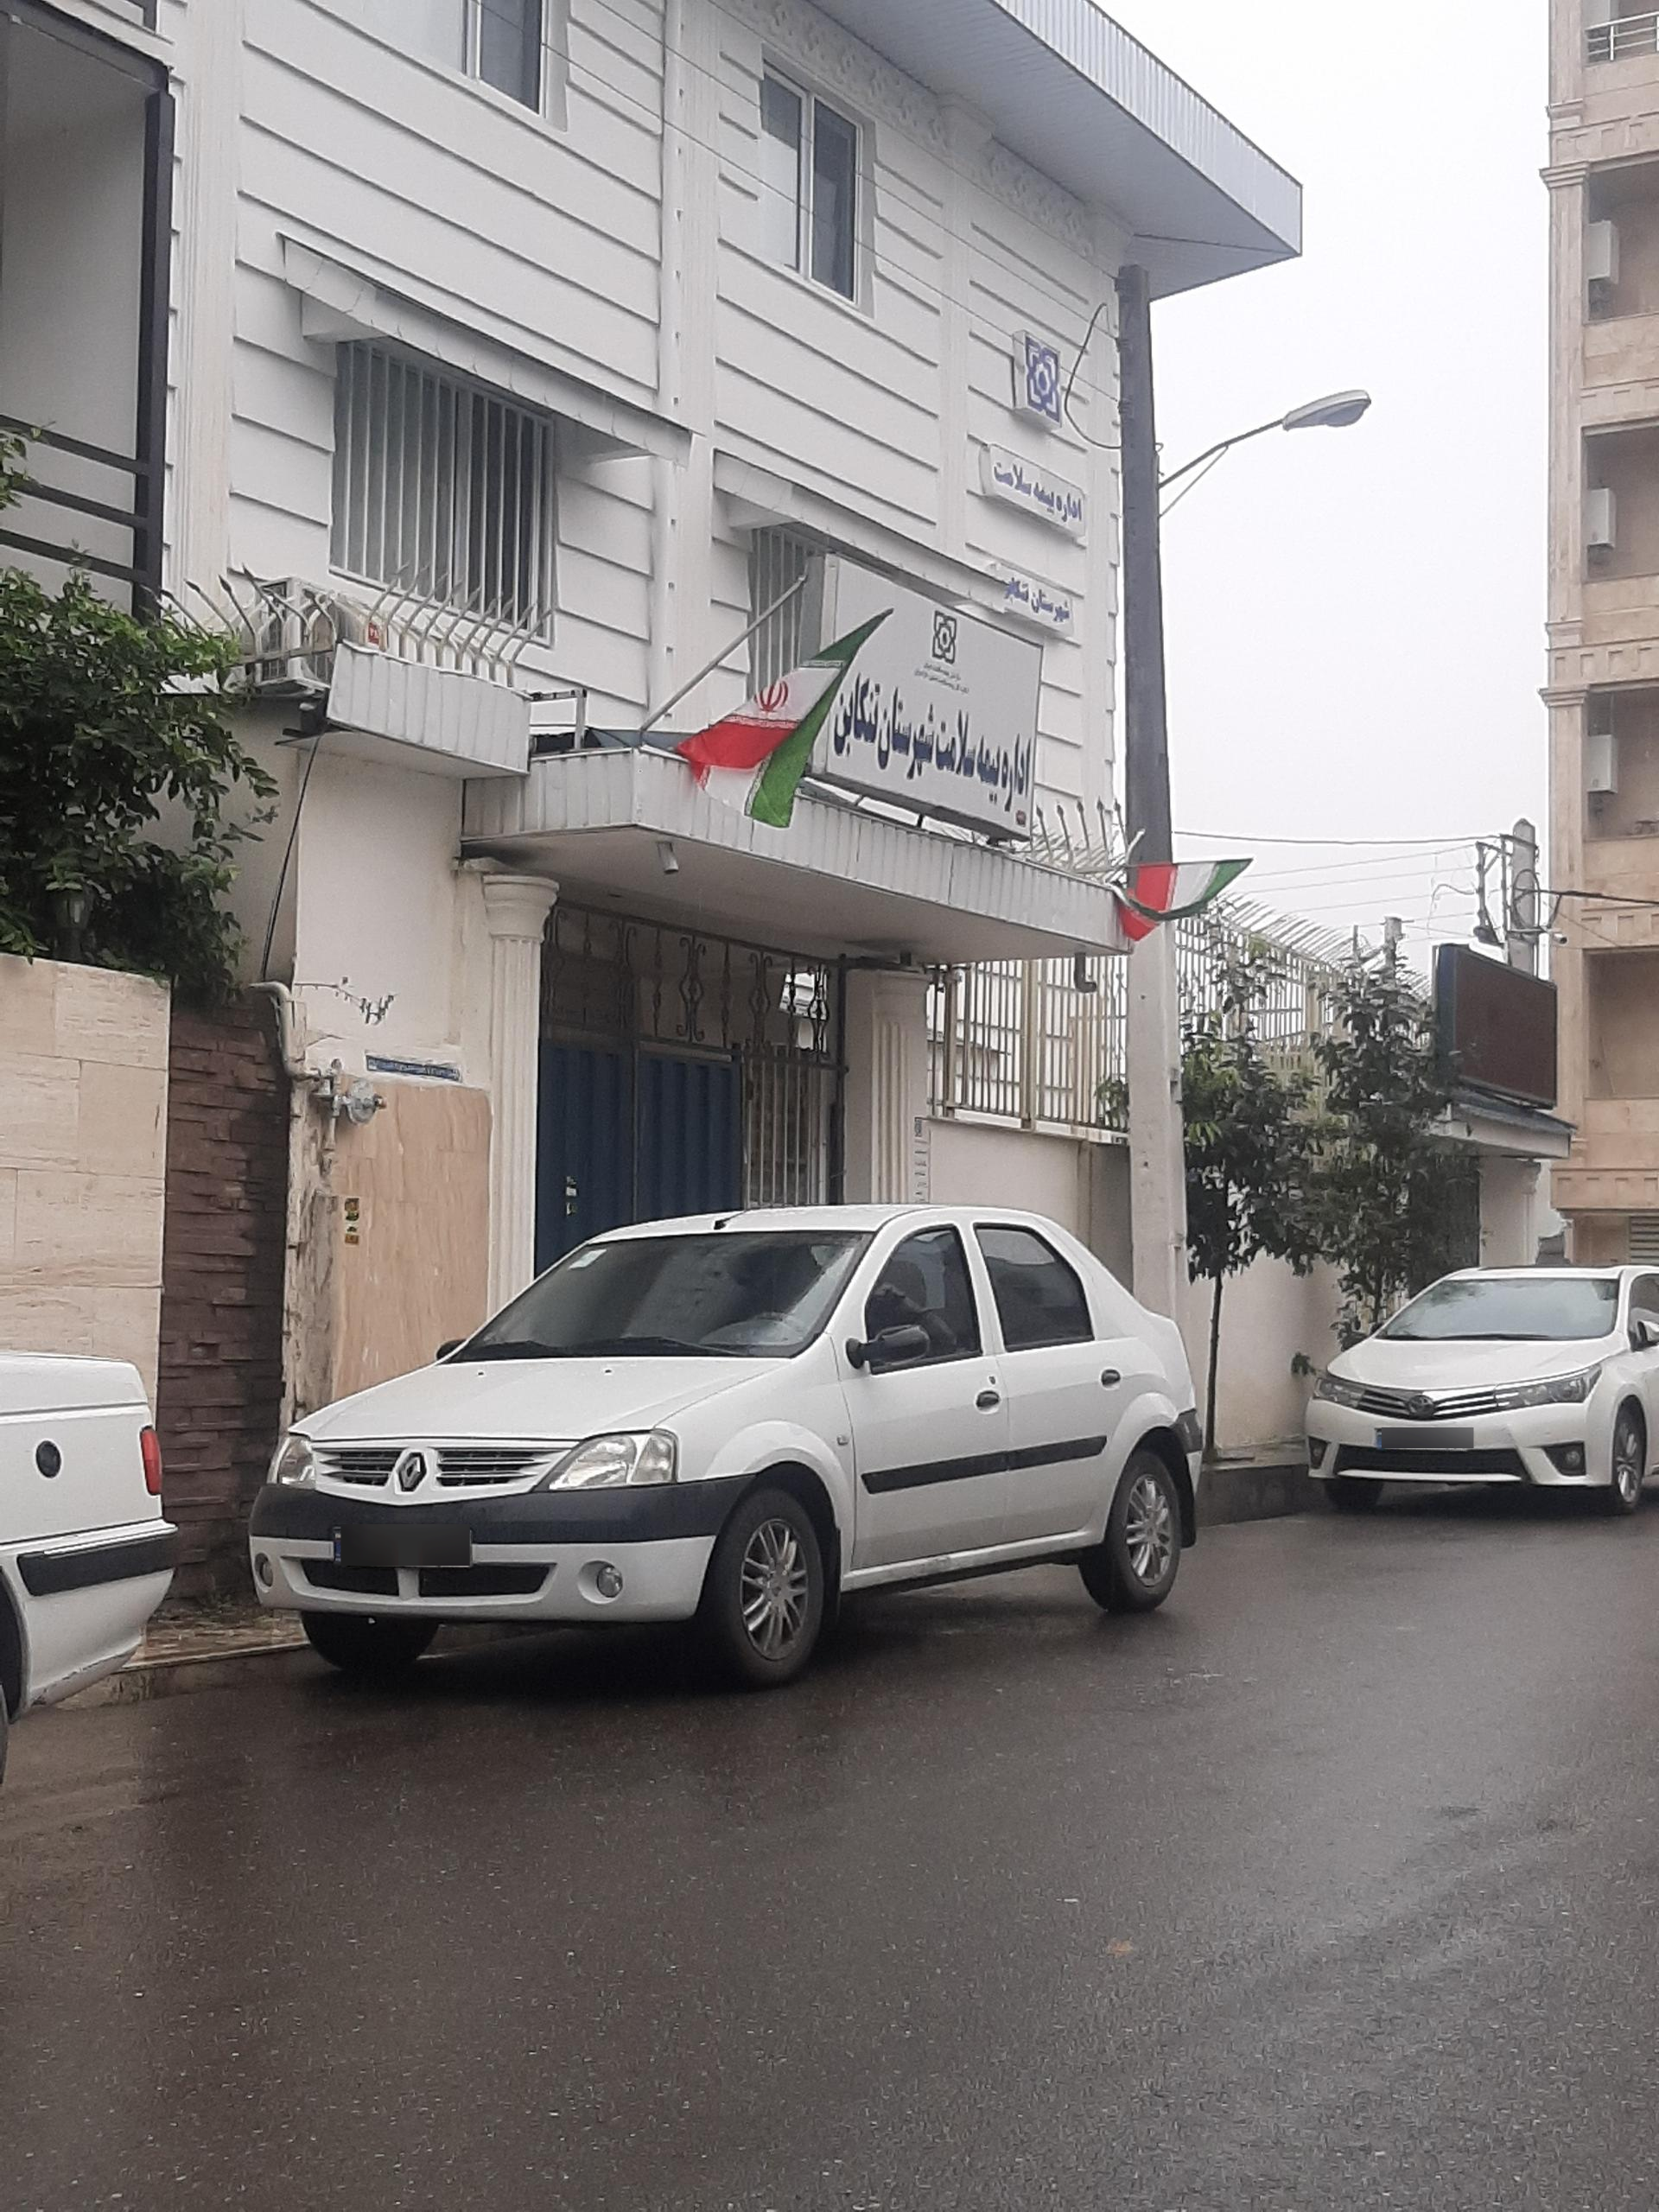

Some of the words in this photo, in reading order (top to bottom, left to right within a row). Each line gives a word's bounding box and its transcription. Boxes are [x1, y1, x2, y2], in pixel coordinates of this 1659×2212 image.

[993, 462, 1032, 496] سلامت
[1056, 492, 1082, 522] اداره
[1031, 588, 1070, 621] شهرستان
[834, 671, 880, 758] تنکابن
[877, 686, 934, 780] شهرستان
[935, 709, 976, 779] سلامت
[976, 734, 1001, 804] بیمه
[1001, 733, 1033, 812] اداره
